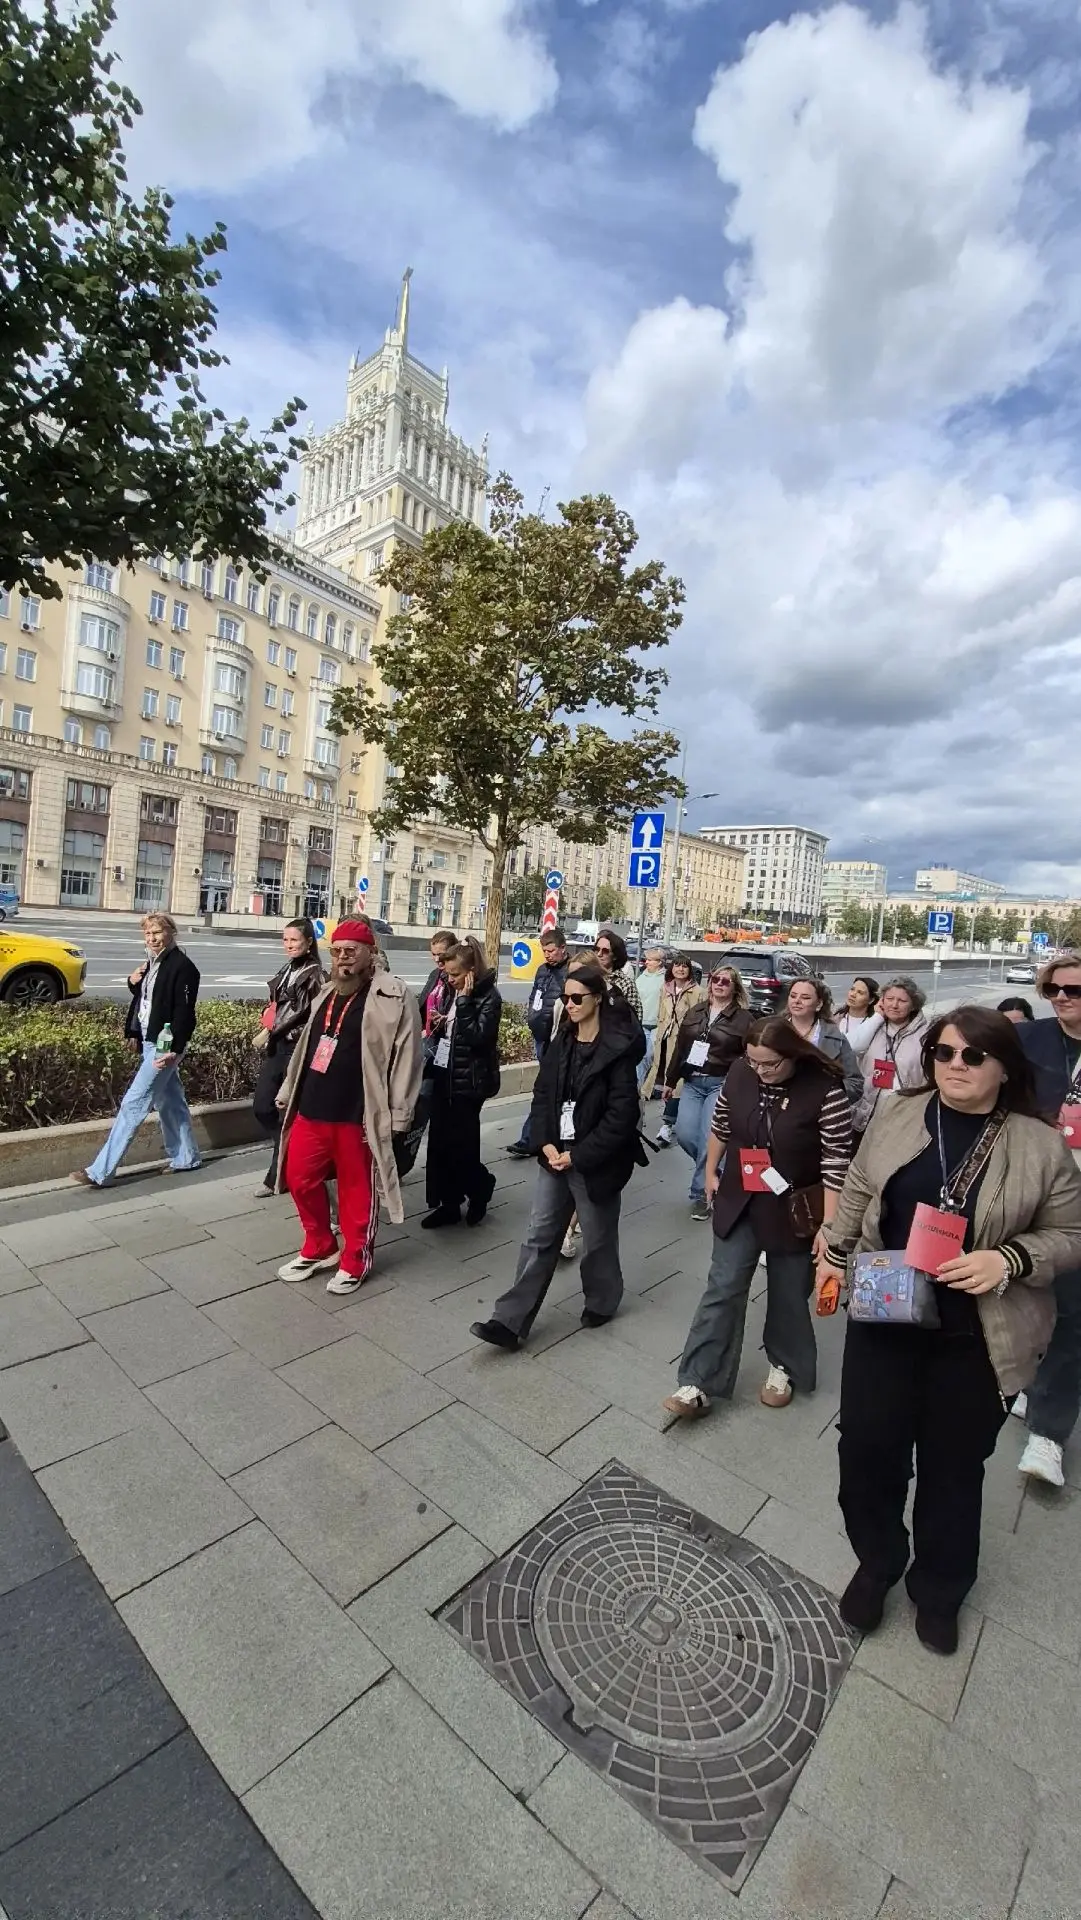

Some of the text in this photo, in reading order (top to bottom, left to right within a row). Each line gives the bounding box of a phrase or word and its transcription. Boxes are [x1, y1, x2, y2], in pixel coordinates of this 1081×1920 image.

[637, 855, 655, 884] P
[934, 913, 949, 931] P
[630, 1594, 682, 1646] В
